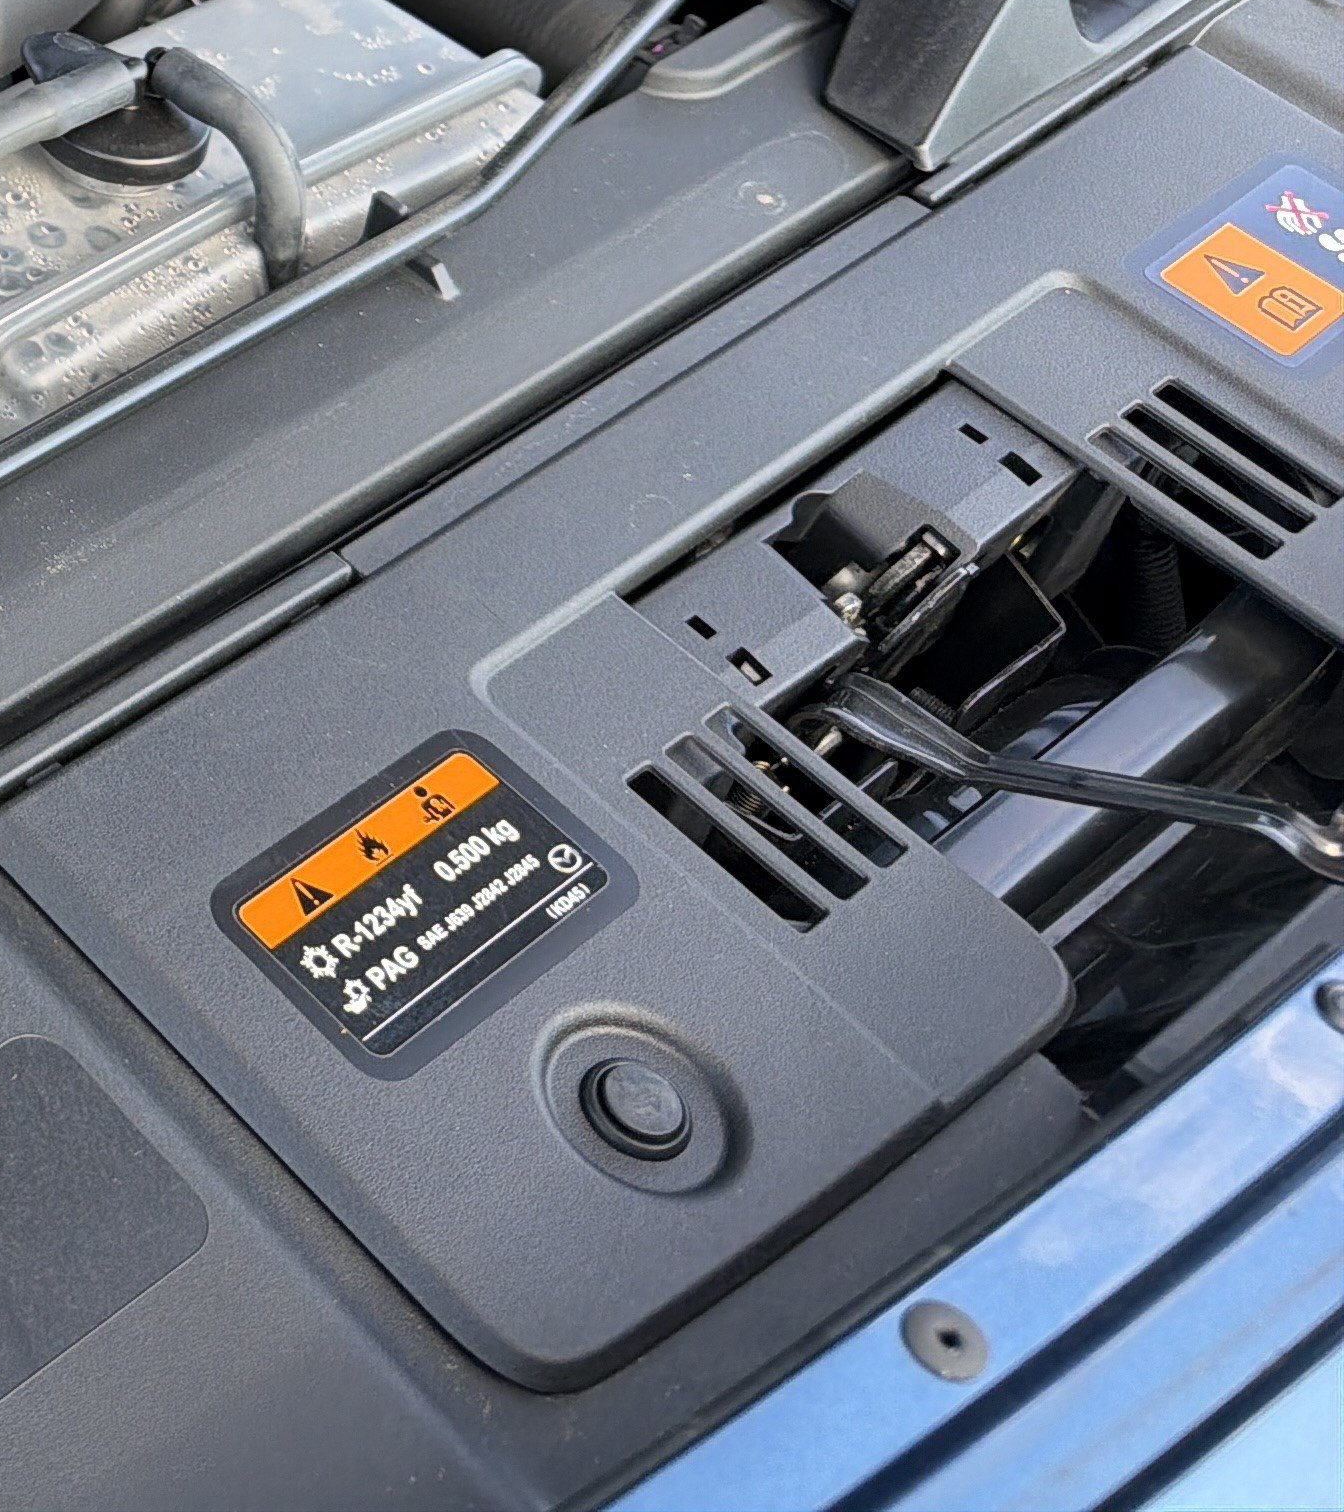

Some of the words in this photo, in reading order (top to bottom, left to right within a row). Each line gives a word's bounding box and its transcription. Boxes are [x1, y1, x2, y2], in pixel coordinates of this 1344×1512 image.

[330, 883, 424, 958] R-1234yf
[433, 834, 492, 883] 0.500
[480, 819, 522, 850] kg
[364, 945, 420, 991] PAG
[416, 922, 450, 951] SAE
[446, 902, 476, 932] J639
[470, 878, 510, 911] J2842
[506, 853, 541, 887] J2845
[544, 882, 592, 920] (KD45)
